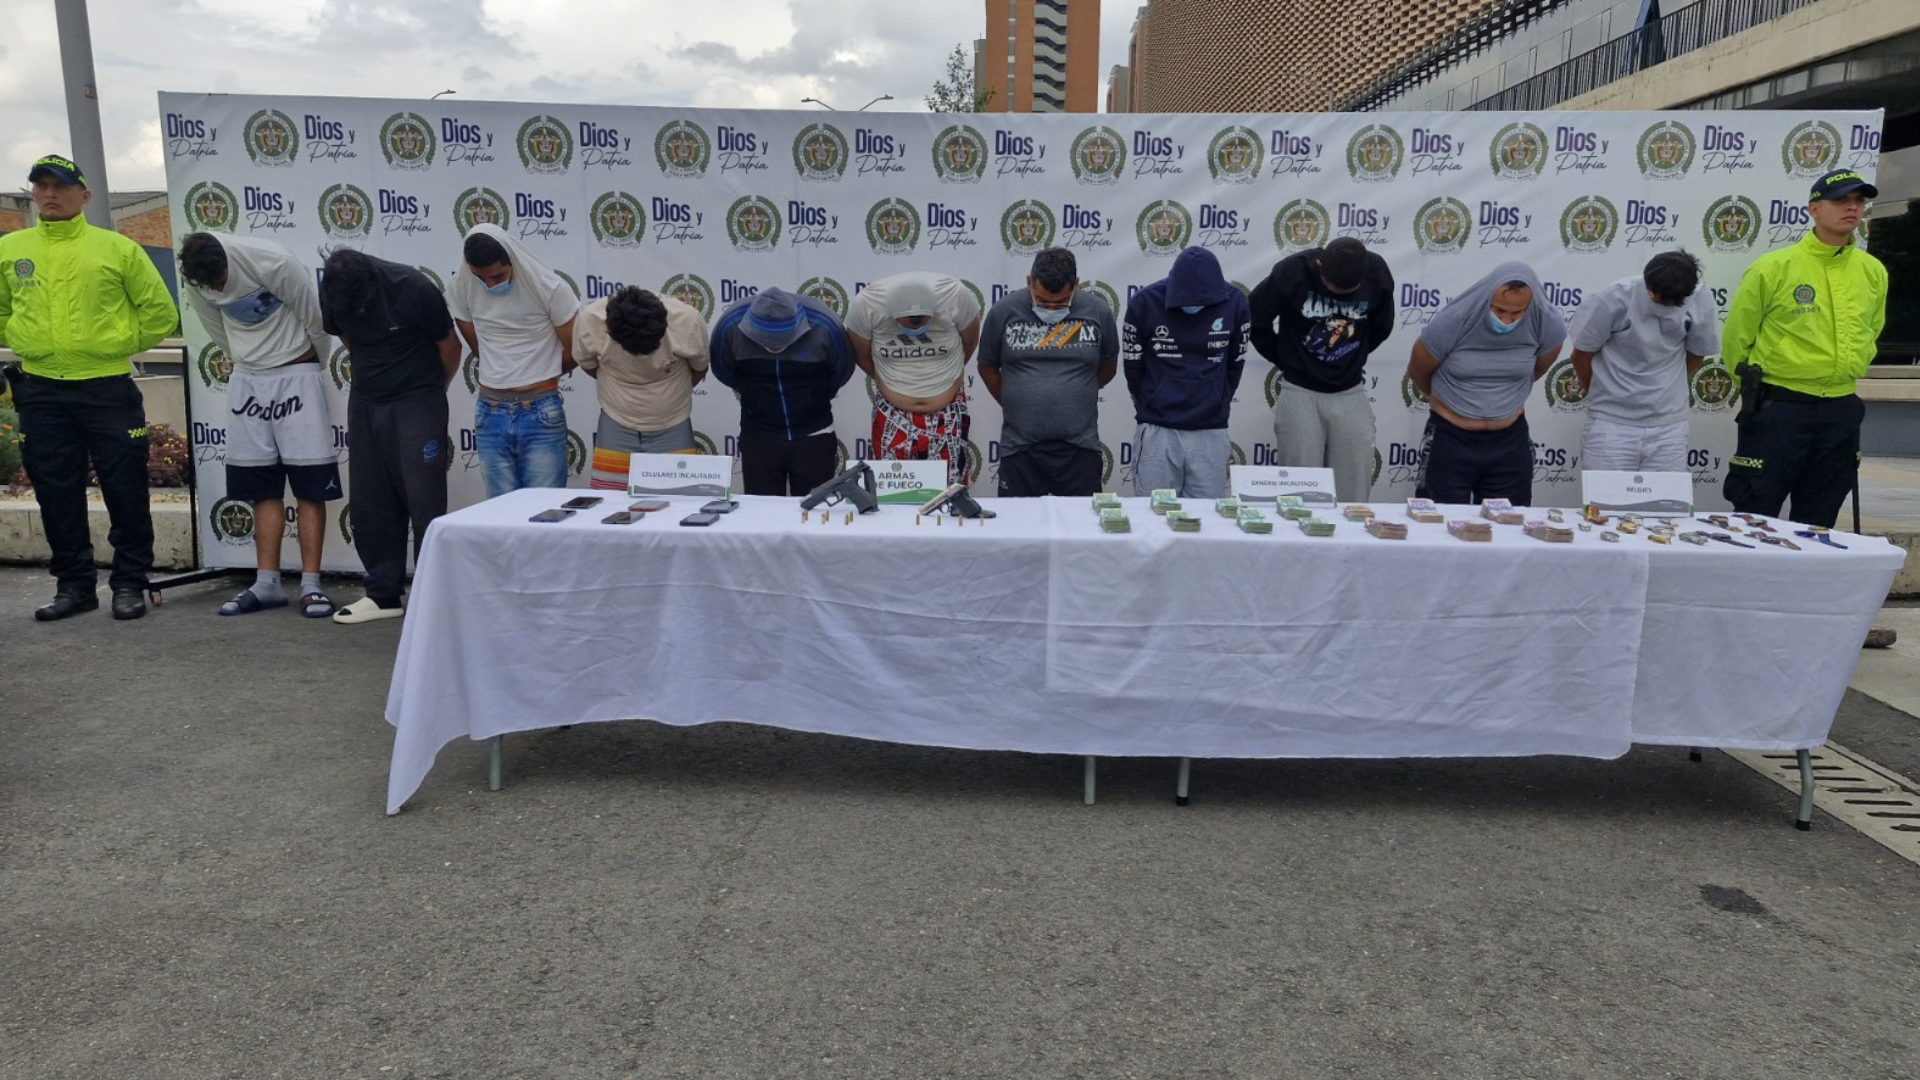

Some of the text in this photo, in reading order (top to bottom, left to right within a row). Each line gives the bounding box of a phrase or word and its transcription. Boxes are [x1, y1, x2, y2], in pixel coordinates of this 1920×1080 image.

[167, 113, 216, 141] Dios y
[304, 114, 355, 144] Dios y
[442, 118, 492, 146] Dios y
[580, 122, 630, 151] Dios y
[1850, 125, 1880, 150] Dio
[169, 139, 218, 159] Patria
[718, 126, 768, 155] Dios y
[856, 128, 905, 157] Dios y
[996, 130, 1045, 158] Dios y
[1134, 130, 1184, 159] Dios y
[1271, 130, 1322, 158] Dios y
[1412, 128, 1464, 156] Dios y
[1556, 126, 1609, 154] Dios y
[1703, 125, 1756, 154] Dios y
[307, 141, 356, 162] Patria
[444, 144, 494, 166] Patria
[581, 148, 631, 170] Patria
[718, 152, 768, 174] Patria
[1555, 152, 1606, 174] Patria
[1702, 152, 1754, 174] Patria
[856, 155, 905, 176] Patria
[995, 156, 1045, 178] Patria
[1133, 156, 1182, 179] Patria
[1271, 156, 1320, 178] Patria
[1411, 154, 1462, 176] Patria
[244, 186, 294, 214] Dios y
[379, 189, 429, 217] Dios y
[515, 193, 566, 222] Dios y
[652, 197, 702, 226] Dios y
[246, 212, 296, 232] Patria
[788, 200, 838, 229] Dios y
[928, 203, 977, 231] Dios y
[1063, 204, 1113, 232] Dios y
[1199, 204, 1250, 231] Dios y
[1338, 203, 1389, 230] Dios y
[1480, 201, 1532, 228] Dios y
[1626, 200, 1678, 227] Dios y
[1769, 200, 1809, 225] Dios
[381, 215, 431, 236] Patria
[517, 218, 567, 240] Patria
[653, 223, 703, 244] Patria
[789, 226, 838, 247] Patria
[1478, 226, 1529, 248] Patria
[1625, 225, 1676, 248] Patria
[1768, 226, 1809, 247] Pat
[928, 228, 976, 250] Patria
[1063, 229, 1112, 250] Patria
[1198, 229, 1248, 250] Patria
[1401, 283, 1440, 307] Dios
[1079, 326, 1096, 341] AX
[880, 346, 947, 358] adidas
[232, 394, 302, 421] Jordan
[1571, 455, 1578, 468] y
[1687, 449, 1720, 470] os y
[878, 472, 915, 480] ARMAS
[887, 481, 923, 490] FUEGO
